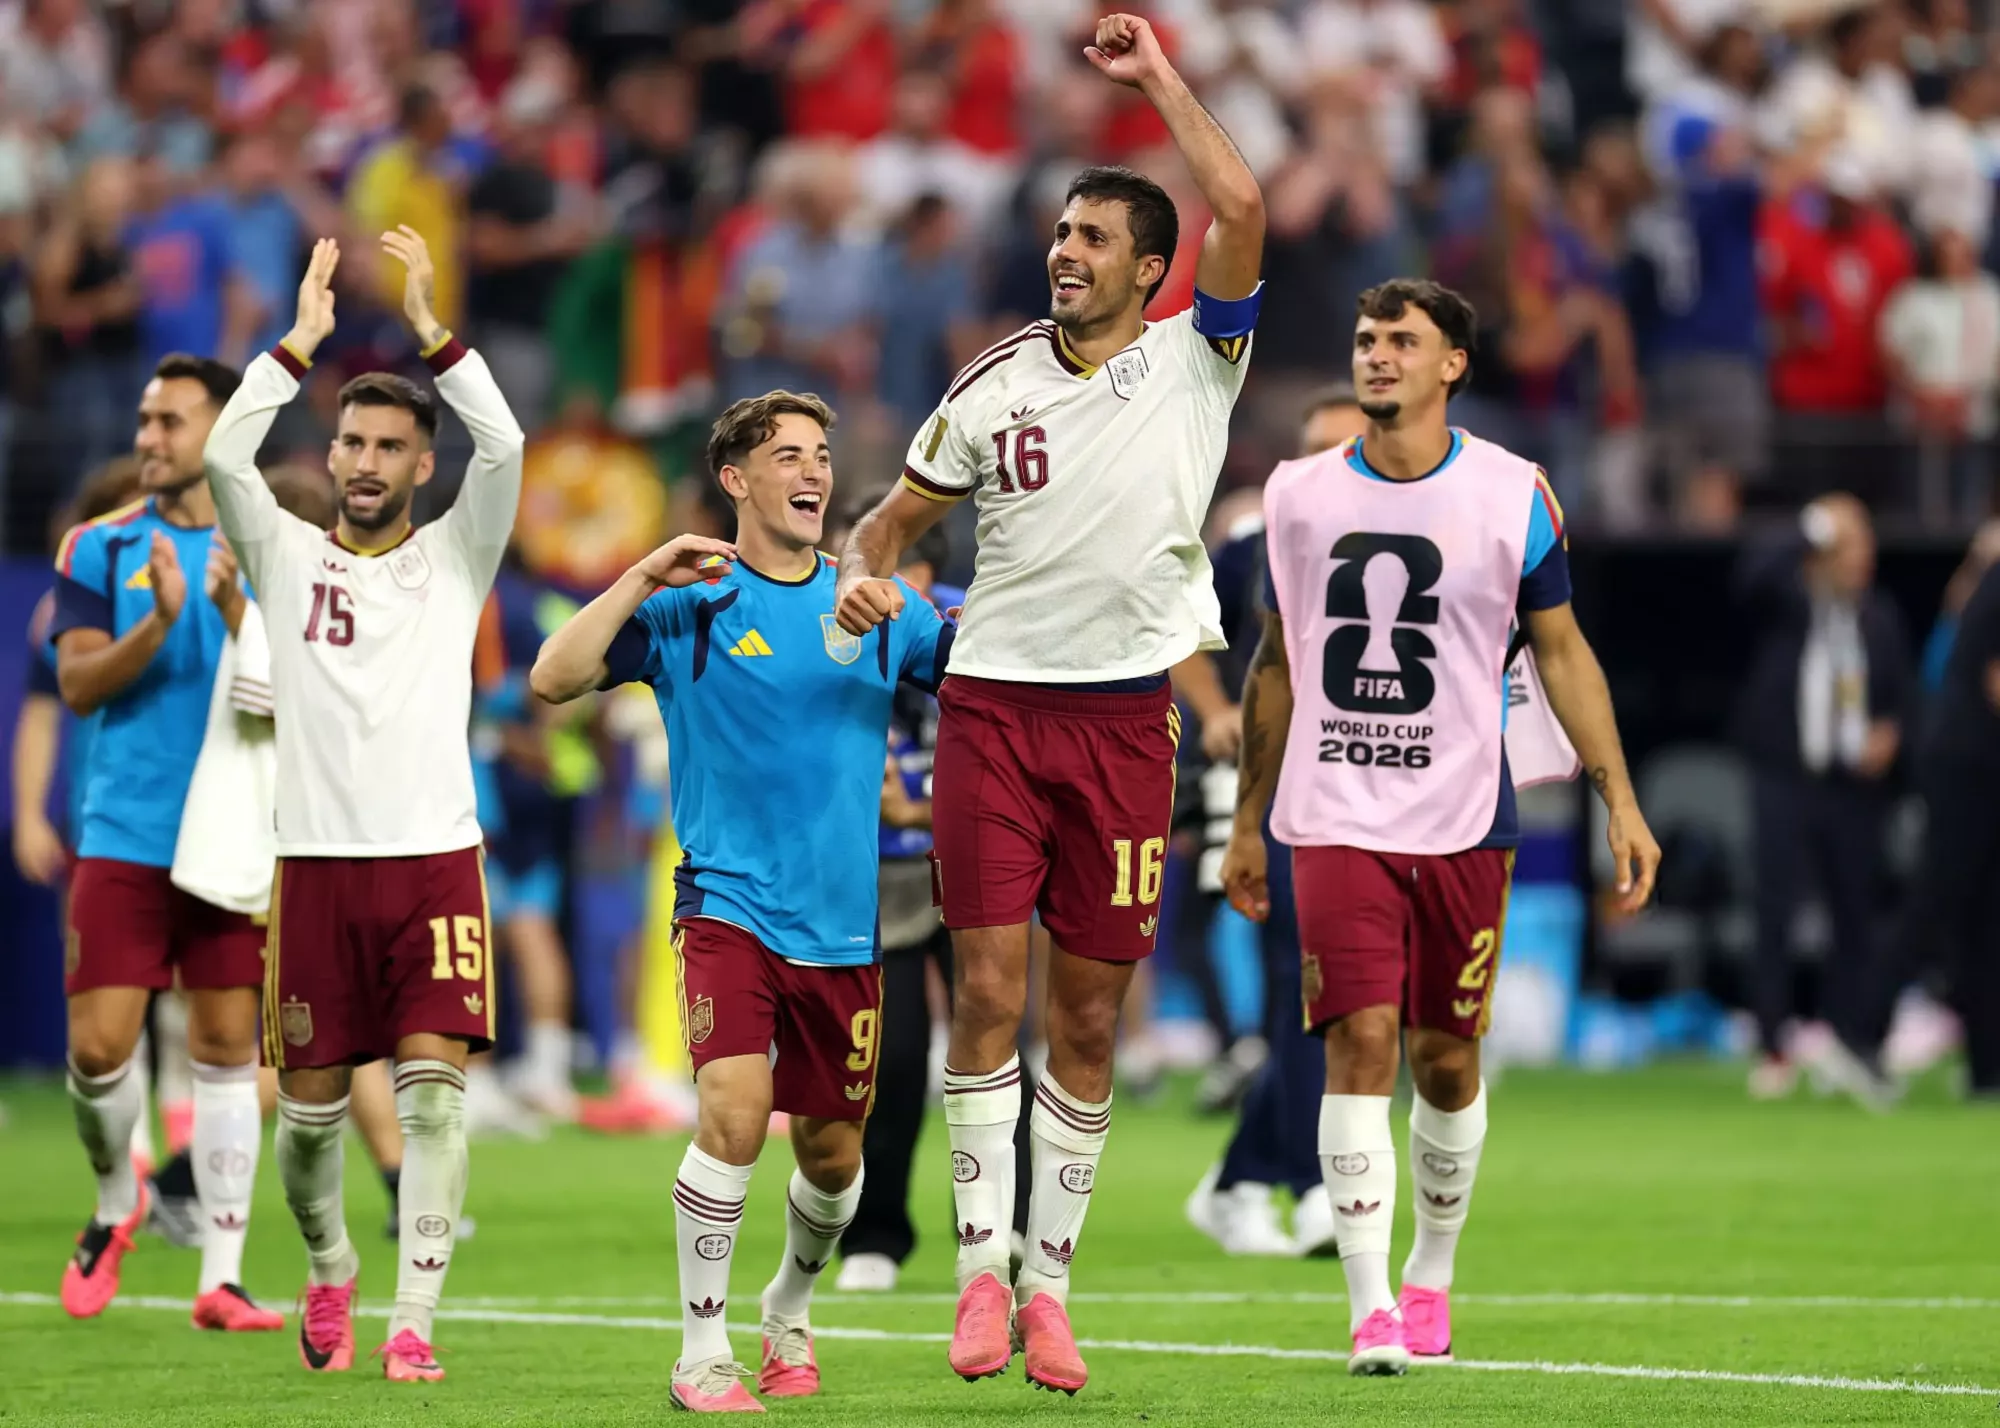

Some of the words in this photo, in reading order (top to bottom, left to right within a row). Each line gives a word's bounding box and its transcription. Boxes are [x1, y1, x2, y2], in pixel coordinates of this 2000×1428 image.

[991, 425, 1049, 493] 16
[303, 583, 355, 647] 15
[1353, 677, 1405, 700] FIFA
[1318, 739, 1432, 769] 2026
[1320, 719, 1390, 738] WORLD
[1393, 725, 1433, 740] CUP
[1110, 836, 1165, 906] 16
[428, 914, 483, 981] 15
[1457, 927, 1495, 988] 2
[845, 1008, 878, 1072] 9
